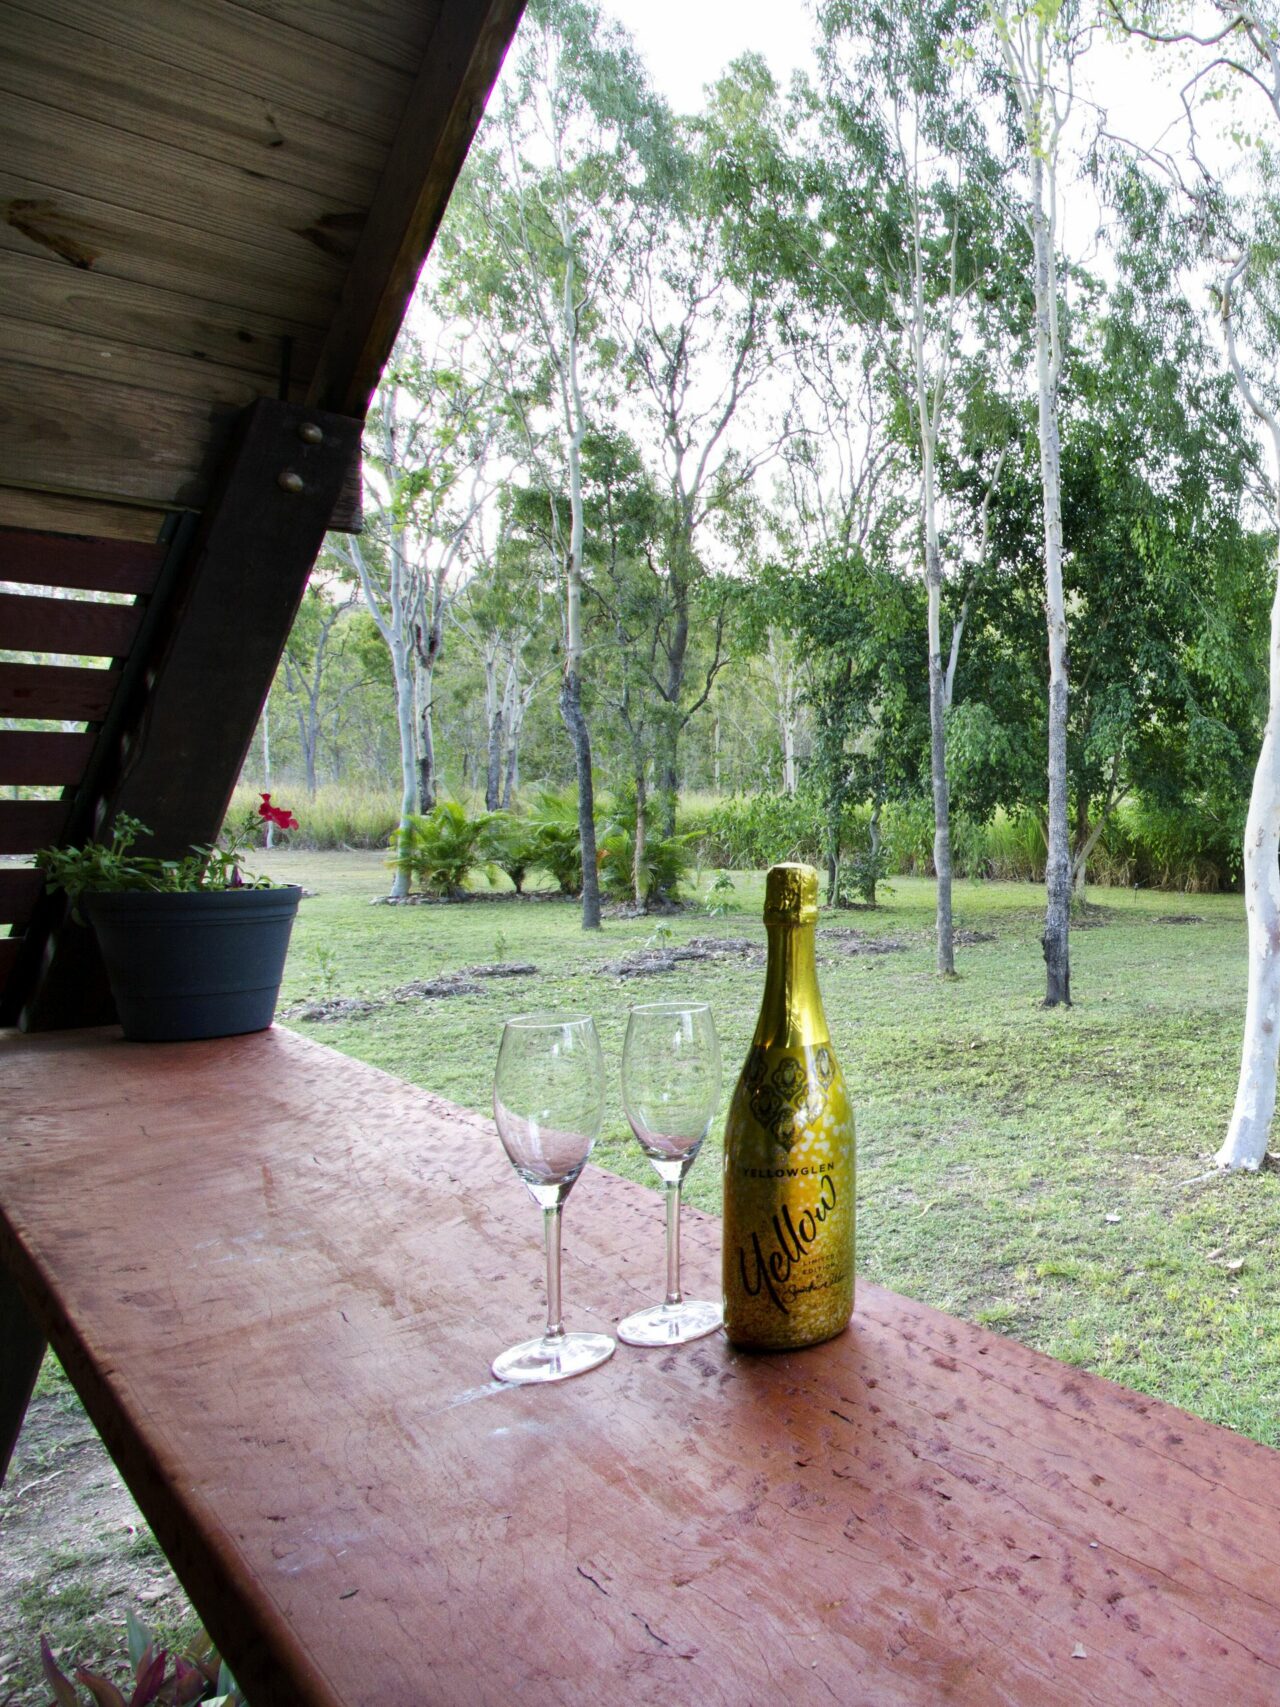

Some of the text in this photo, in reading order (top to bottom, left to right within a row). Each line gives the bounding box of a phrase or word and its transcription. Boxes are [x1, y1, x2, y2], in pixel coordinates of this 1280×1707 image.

[743, 1161, 835, 1178] YELLOWGLEN
[740, 1174, 836, 1315] Yellow
[802, 1254, 835, 1266] LIMITED
[802, 1262, 836, 1275] EDITION
